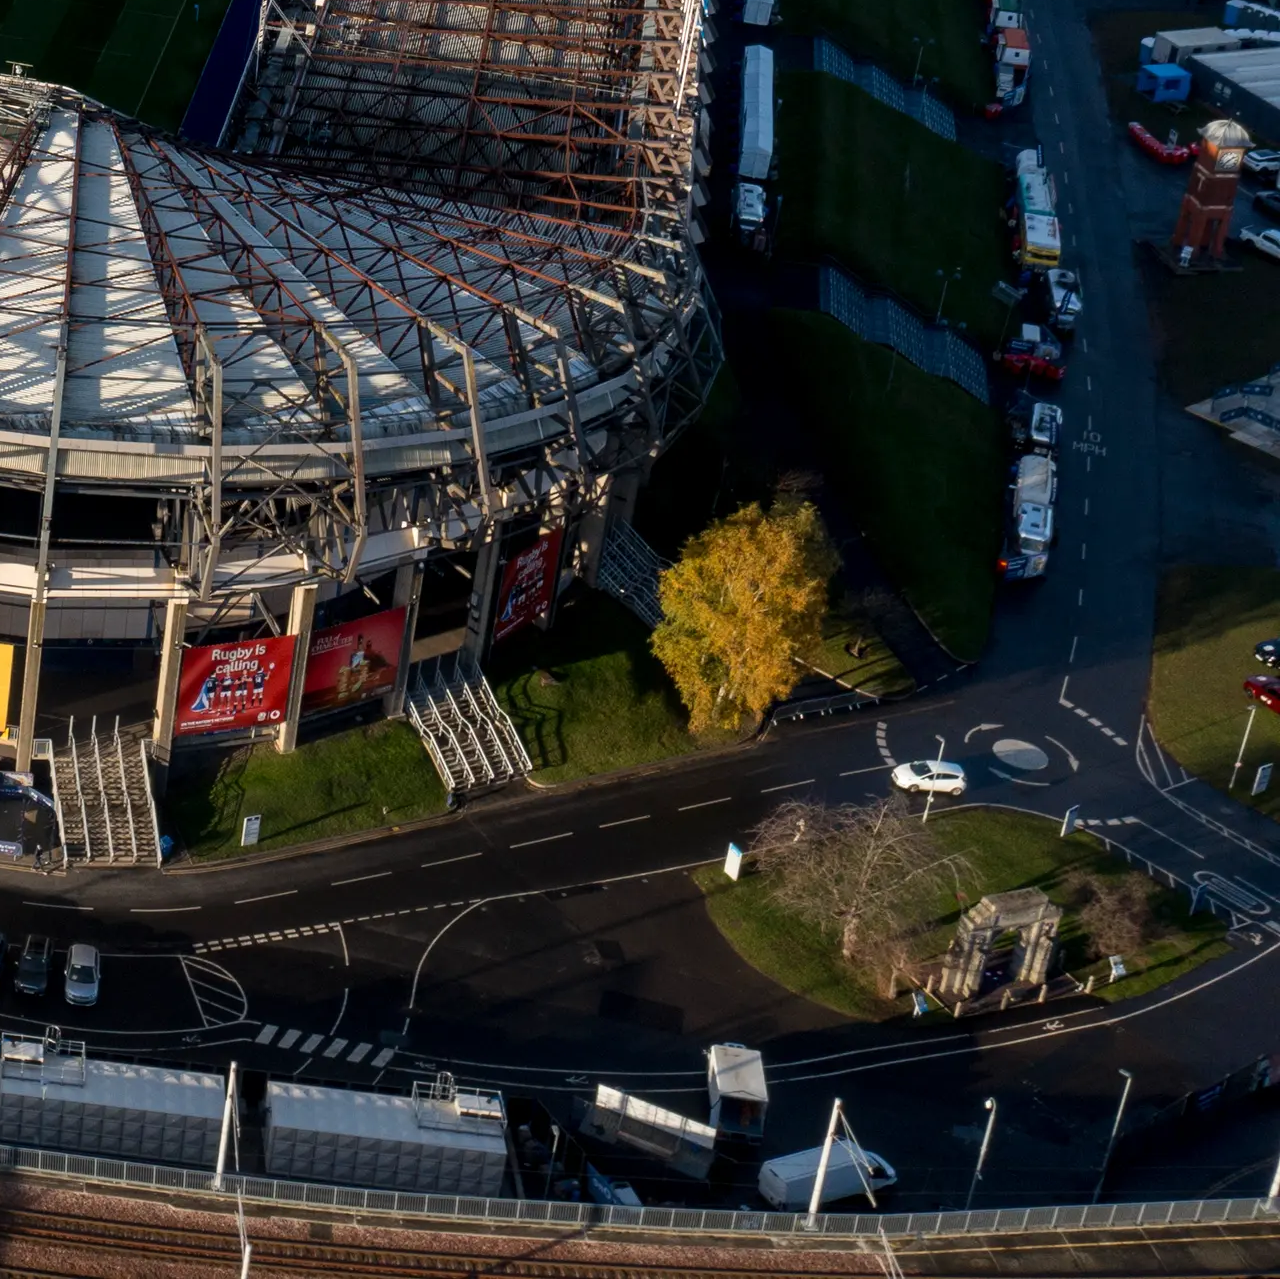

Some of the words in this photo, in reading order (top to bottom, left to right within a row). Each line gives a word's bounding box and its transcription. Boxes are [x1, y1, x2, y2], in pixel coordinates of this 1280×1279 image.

[1072, 440, 1107, 457] MPH
[211, 647, 253, 662] Rugby
[255, 644, 266, 655] is
[215, 660, 258, 674] calling
